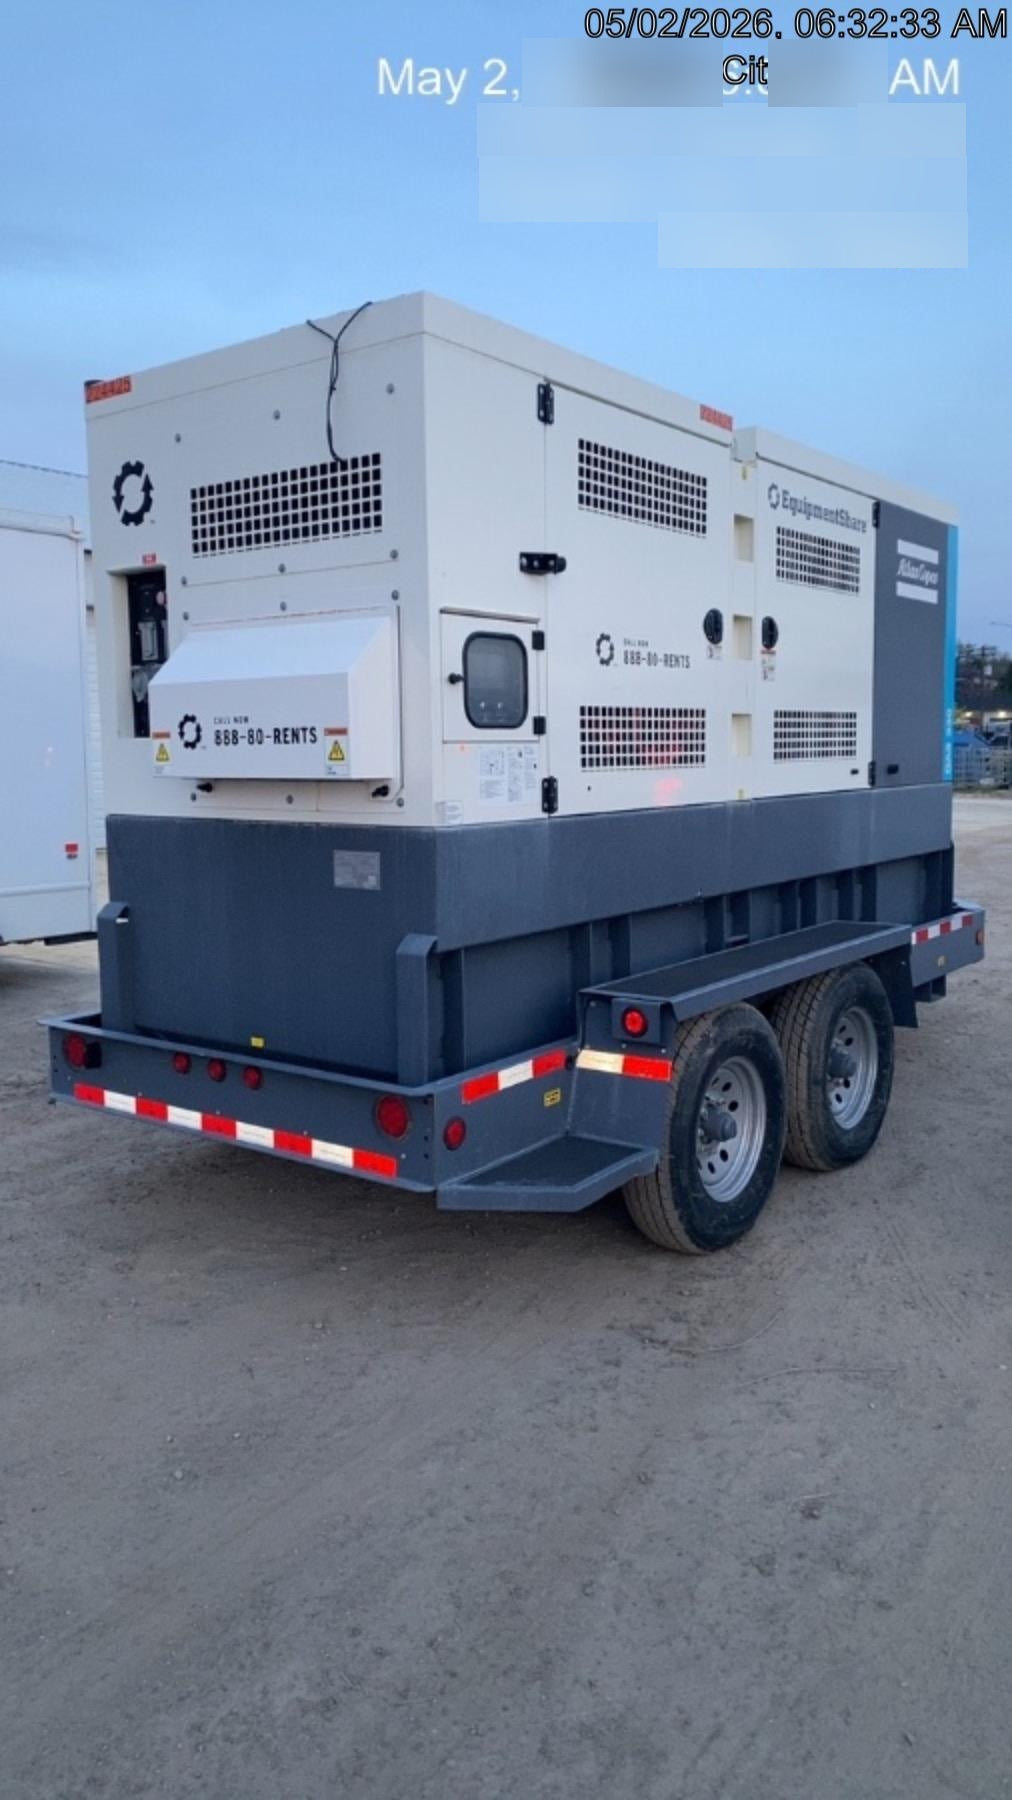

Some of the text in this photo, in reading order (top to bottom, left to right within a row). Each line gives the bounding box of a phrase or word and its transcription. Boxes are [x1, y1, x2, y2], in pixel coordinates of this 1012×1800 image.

[782, 489, 867, 533] EquipmentShare
[623, 649, 690, 669] 888-80-RENTS
[214, 725, 318, 747] 888-80-RENTS
